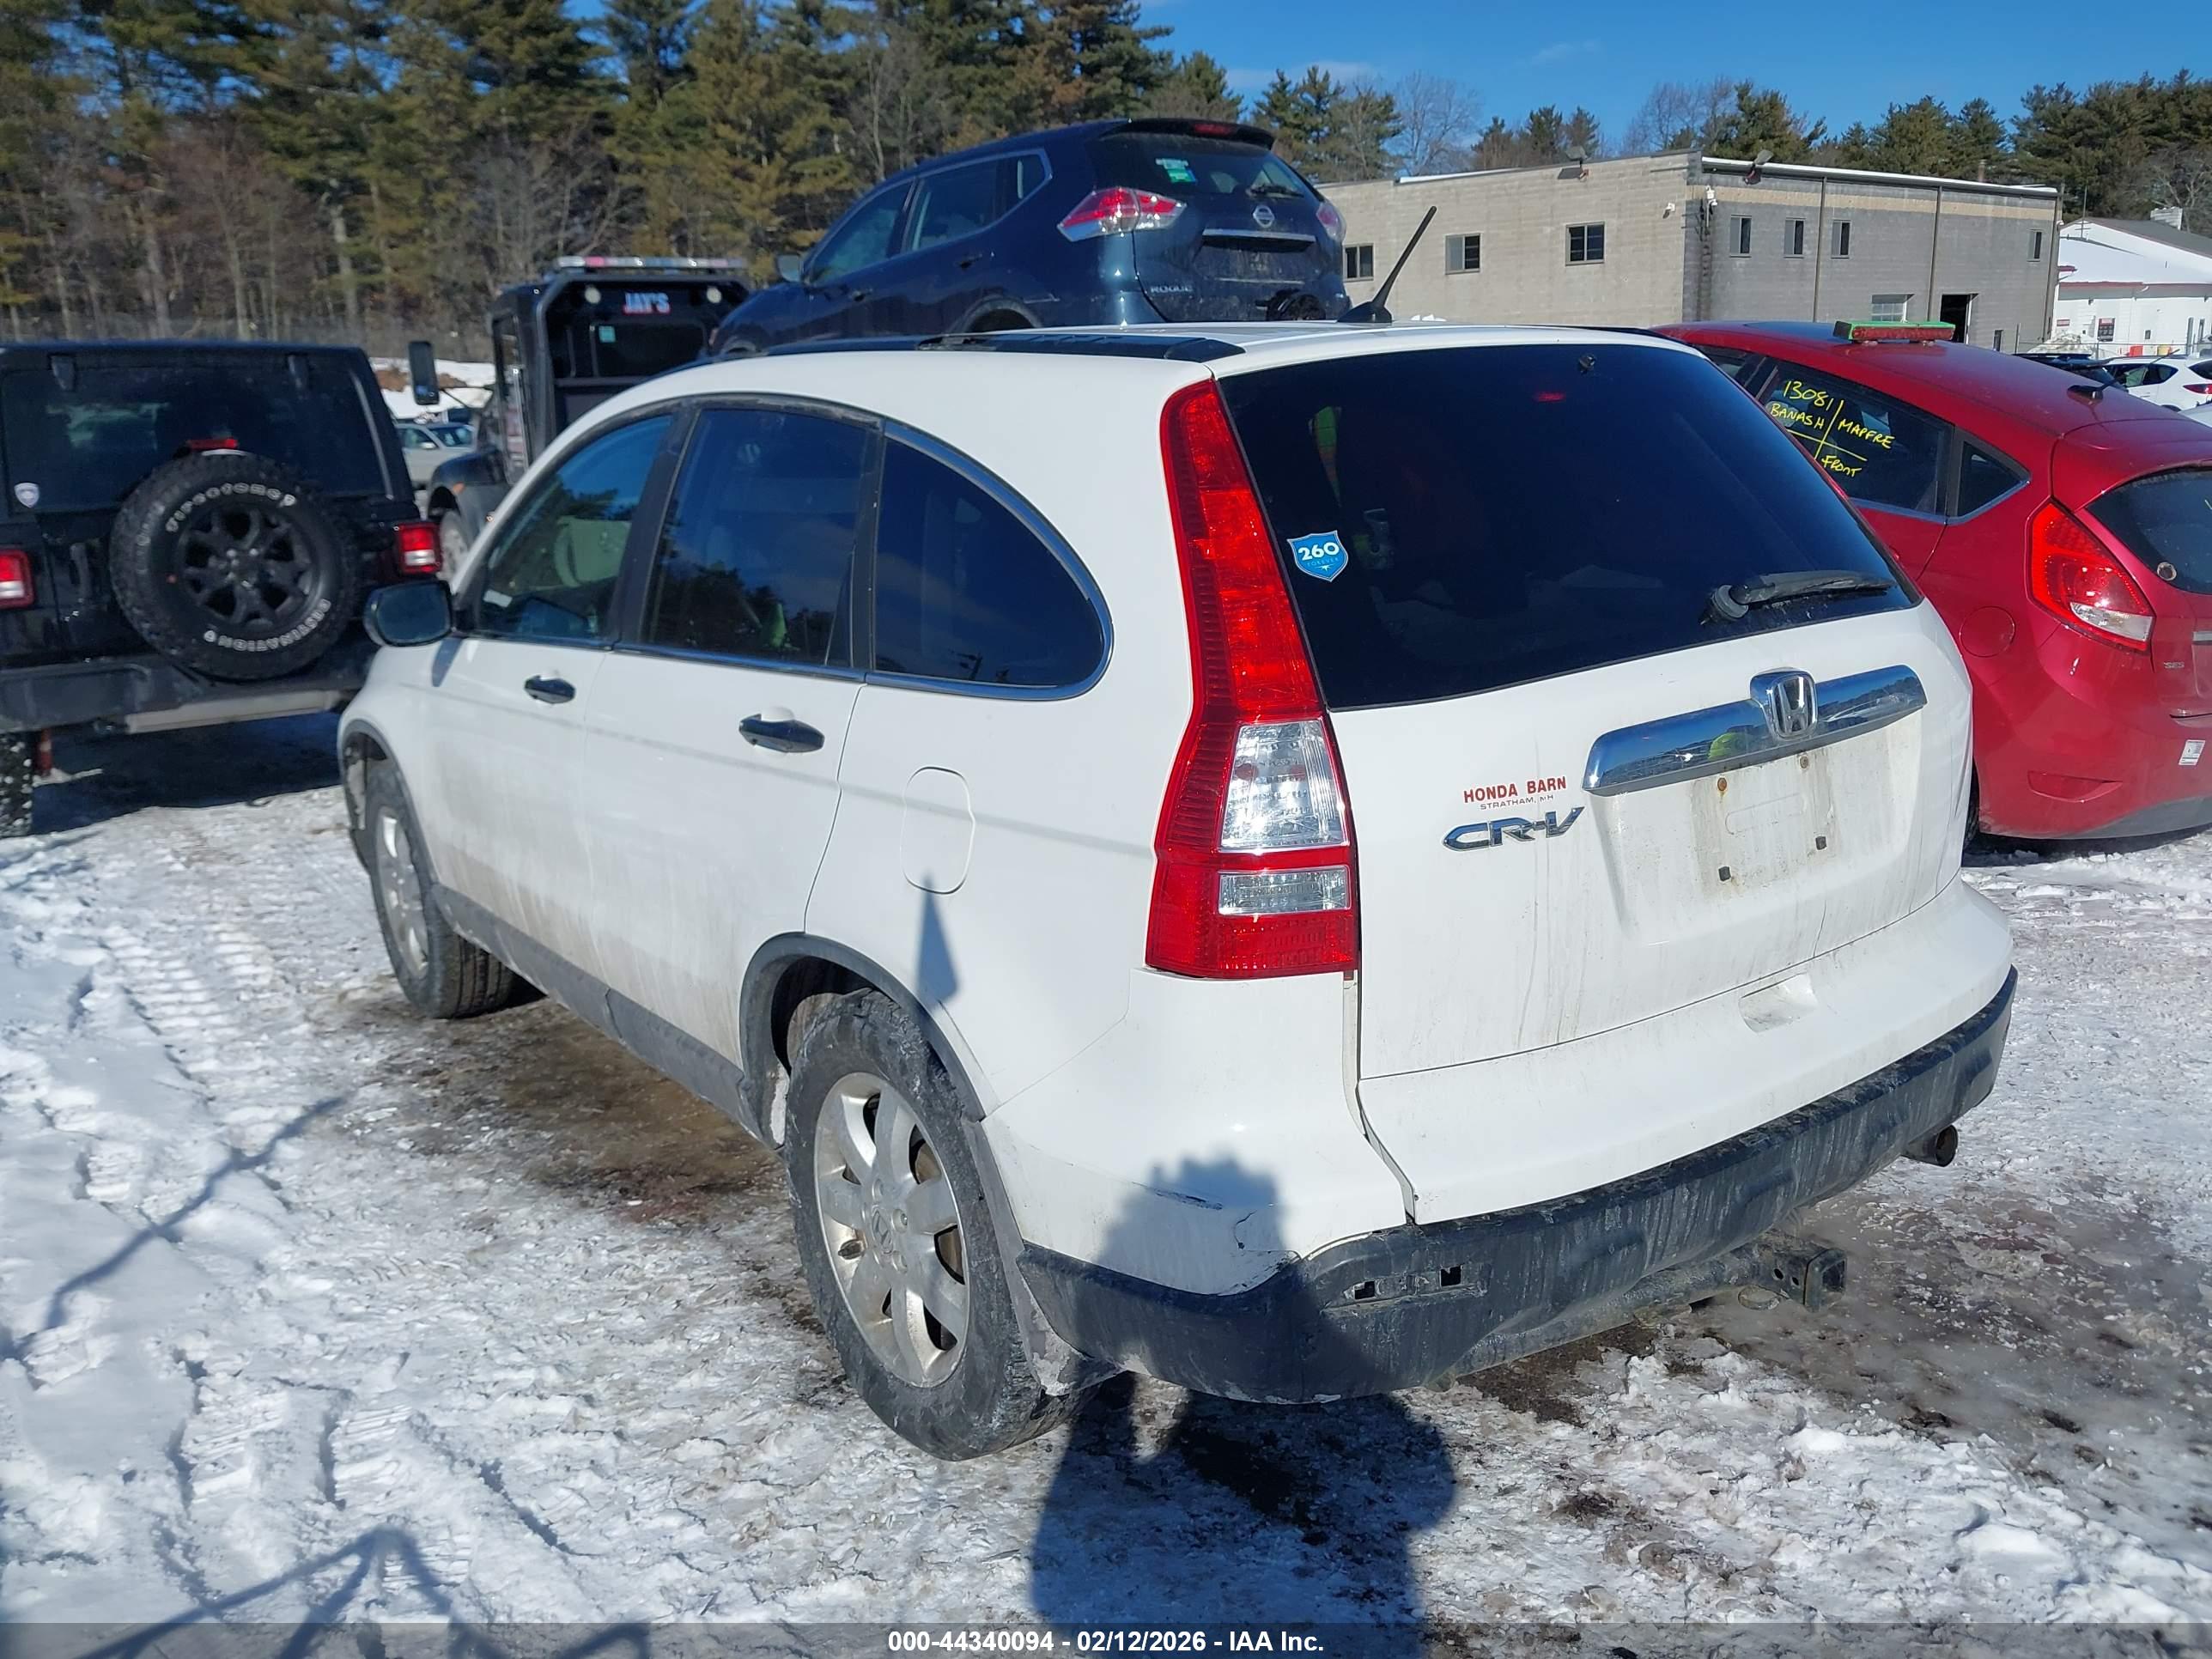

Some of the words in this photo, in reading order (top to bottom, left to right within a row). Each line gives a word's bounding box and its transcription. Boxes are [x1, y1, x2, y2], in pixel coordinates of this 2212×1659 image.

[1784, 380, 1832, 411] 13081
[1770, 404, 1824, 429] BANASH
[1838, 418, 1895, 449] MAPFRE
[1298, 542, 1340, 561] 260
[1307, 557, 1339, 567] FOREVER
[1463, 783, 1518, 803] HONDA
[1527, 776, 1566, 794] BARN
[1480, 797, 1536, 811] STRATHAM,
[1443, 806, 1584, 852] CR-V
